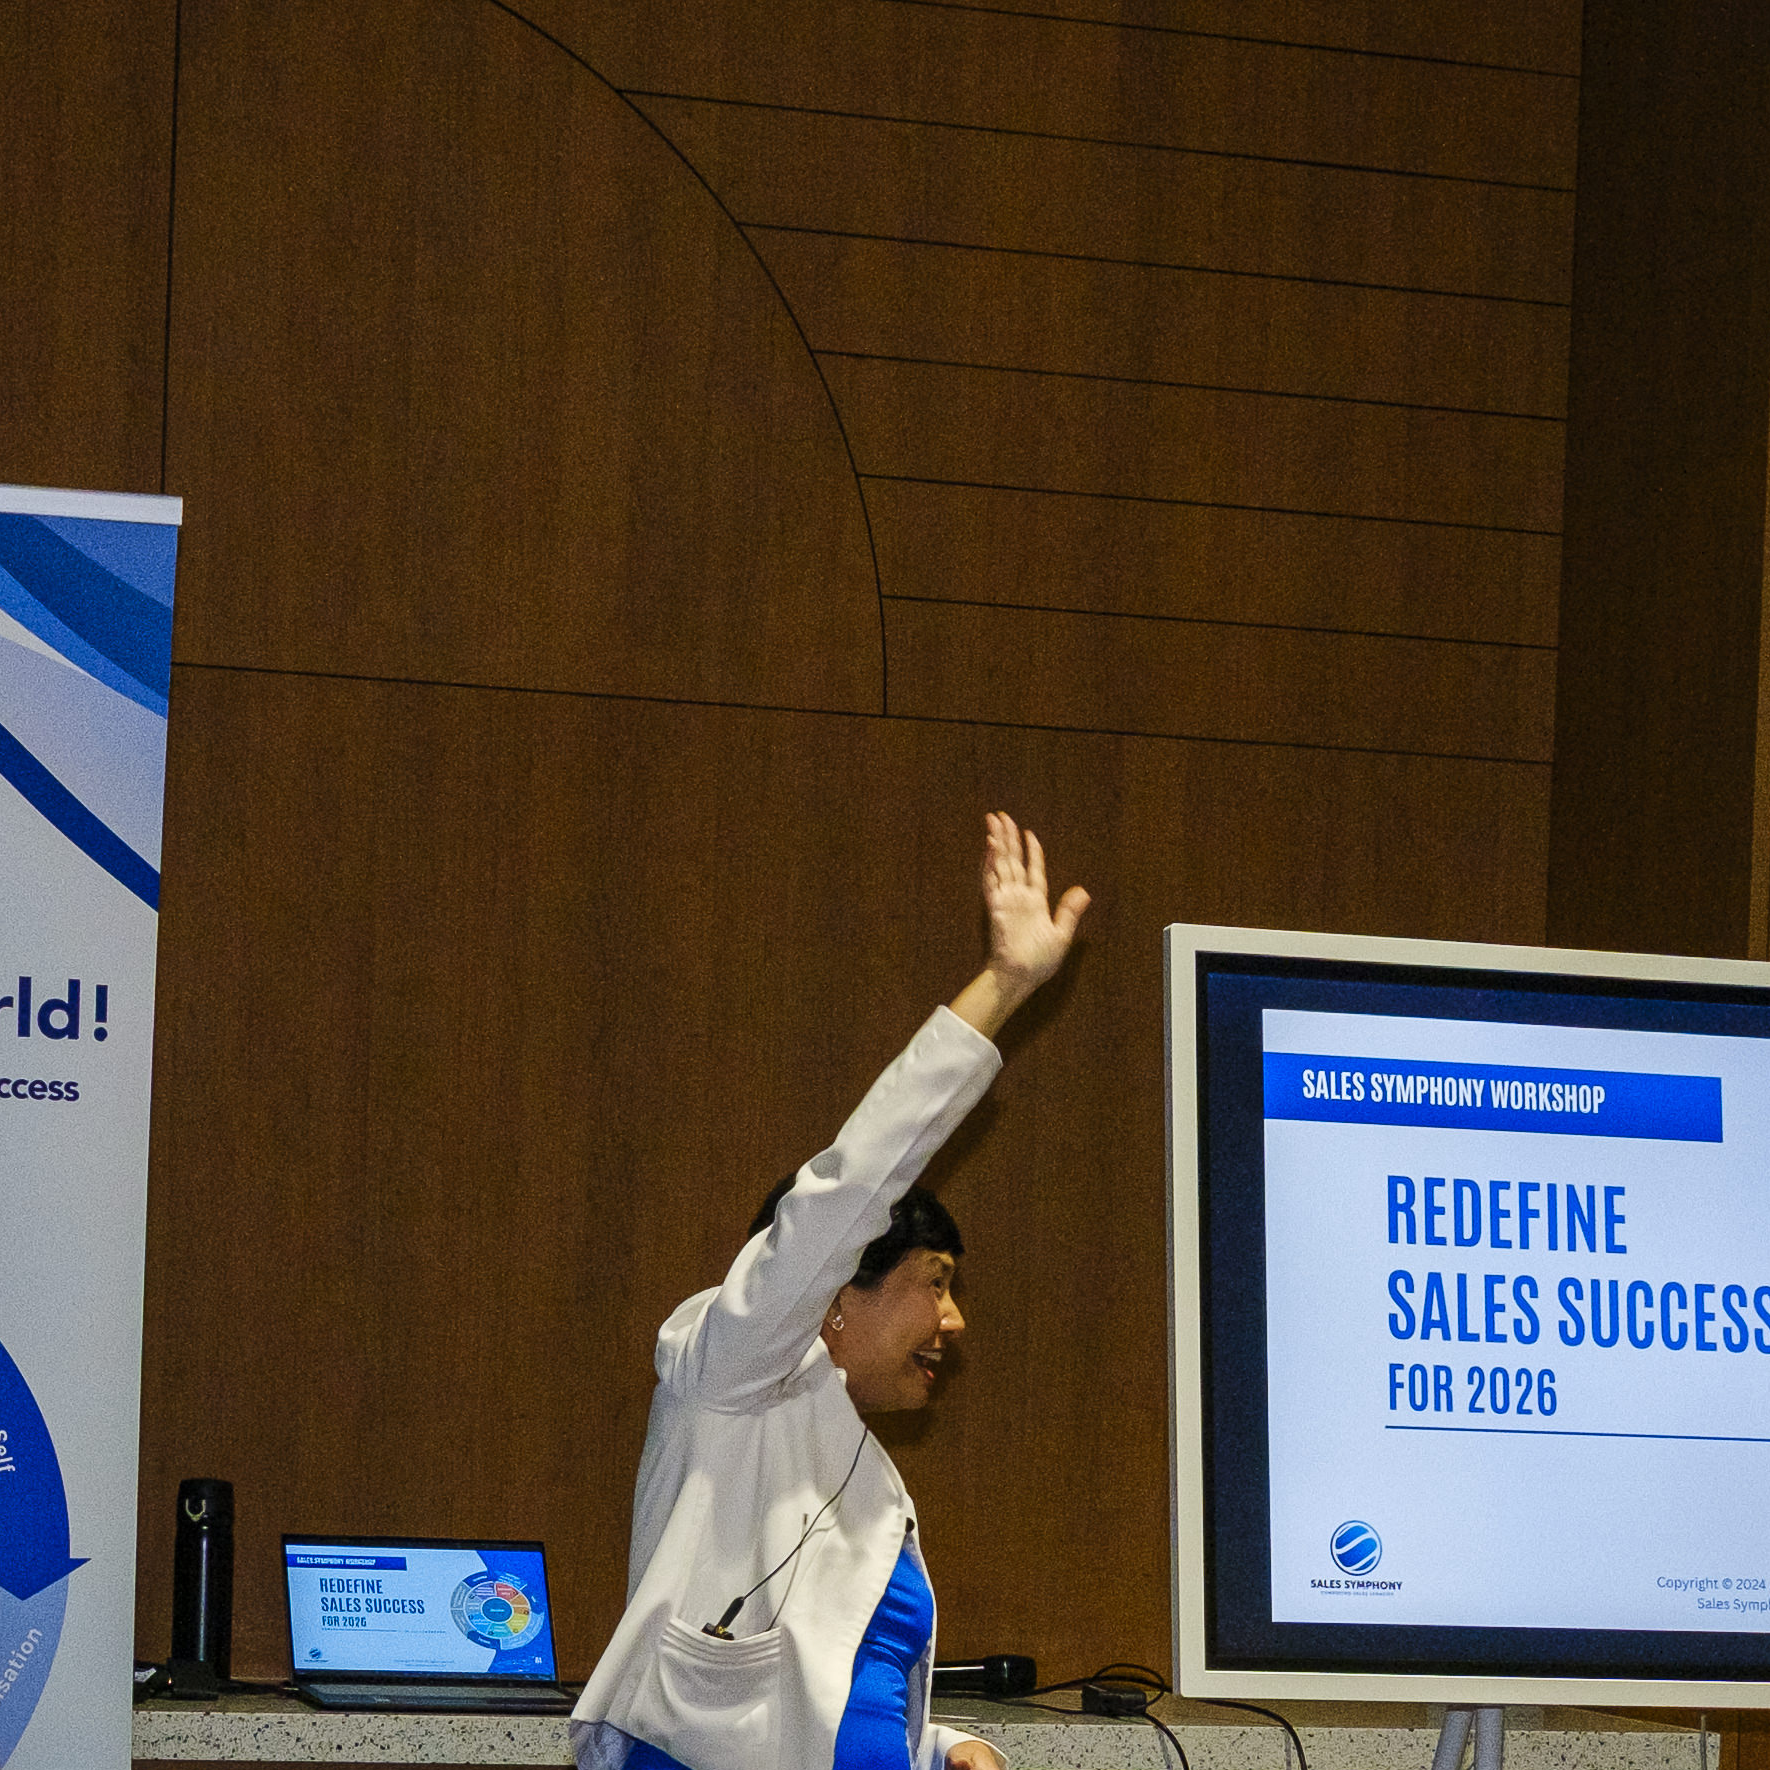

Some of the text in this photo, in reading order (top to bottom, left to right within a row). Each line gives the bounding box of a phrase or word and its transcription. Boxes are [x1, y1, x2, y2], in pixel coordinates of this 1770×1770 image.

[1302, 1067, 1606, 1115] SALES SYMPHONY WORKSHOP
[1386, 1173, 1628, 1257] REDEFINE
[1387, 1270, 1541, 1346] SALES
[1388, 1365, 1558, 1417] FOR 2026
[319, 1577, 384, 1594] REDEFINE
[1310, 1578, 1403, 1592] SALES SYMPHONY
[1657, 1576, 1719, 1593] Copyright
[1736, 1578, 1766, 1591] 2024
[321, 1597, 425, 1614] SALES SUCCESS
[1697, 1597, 1730, 1610] Sales
[322, 1615, 340, 1627] FOR
